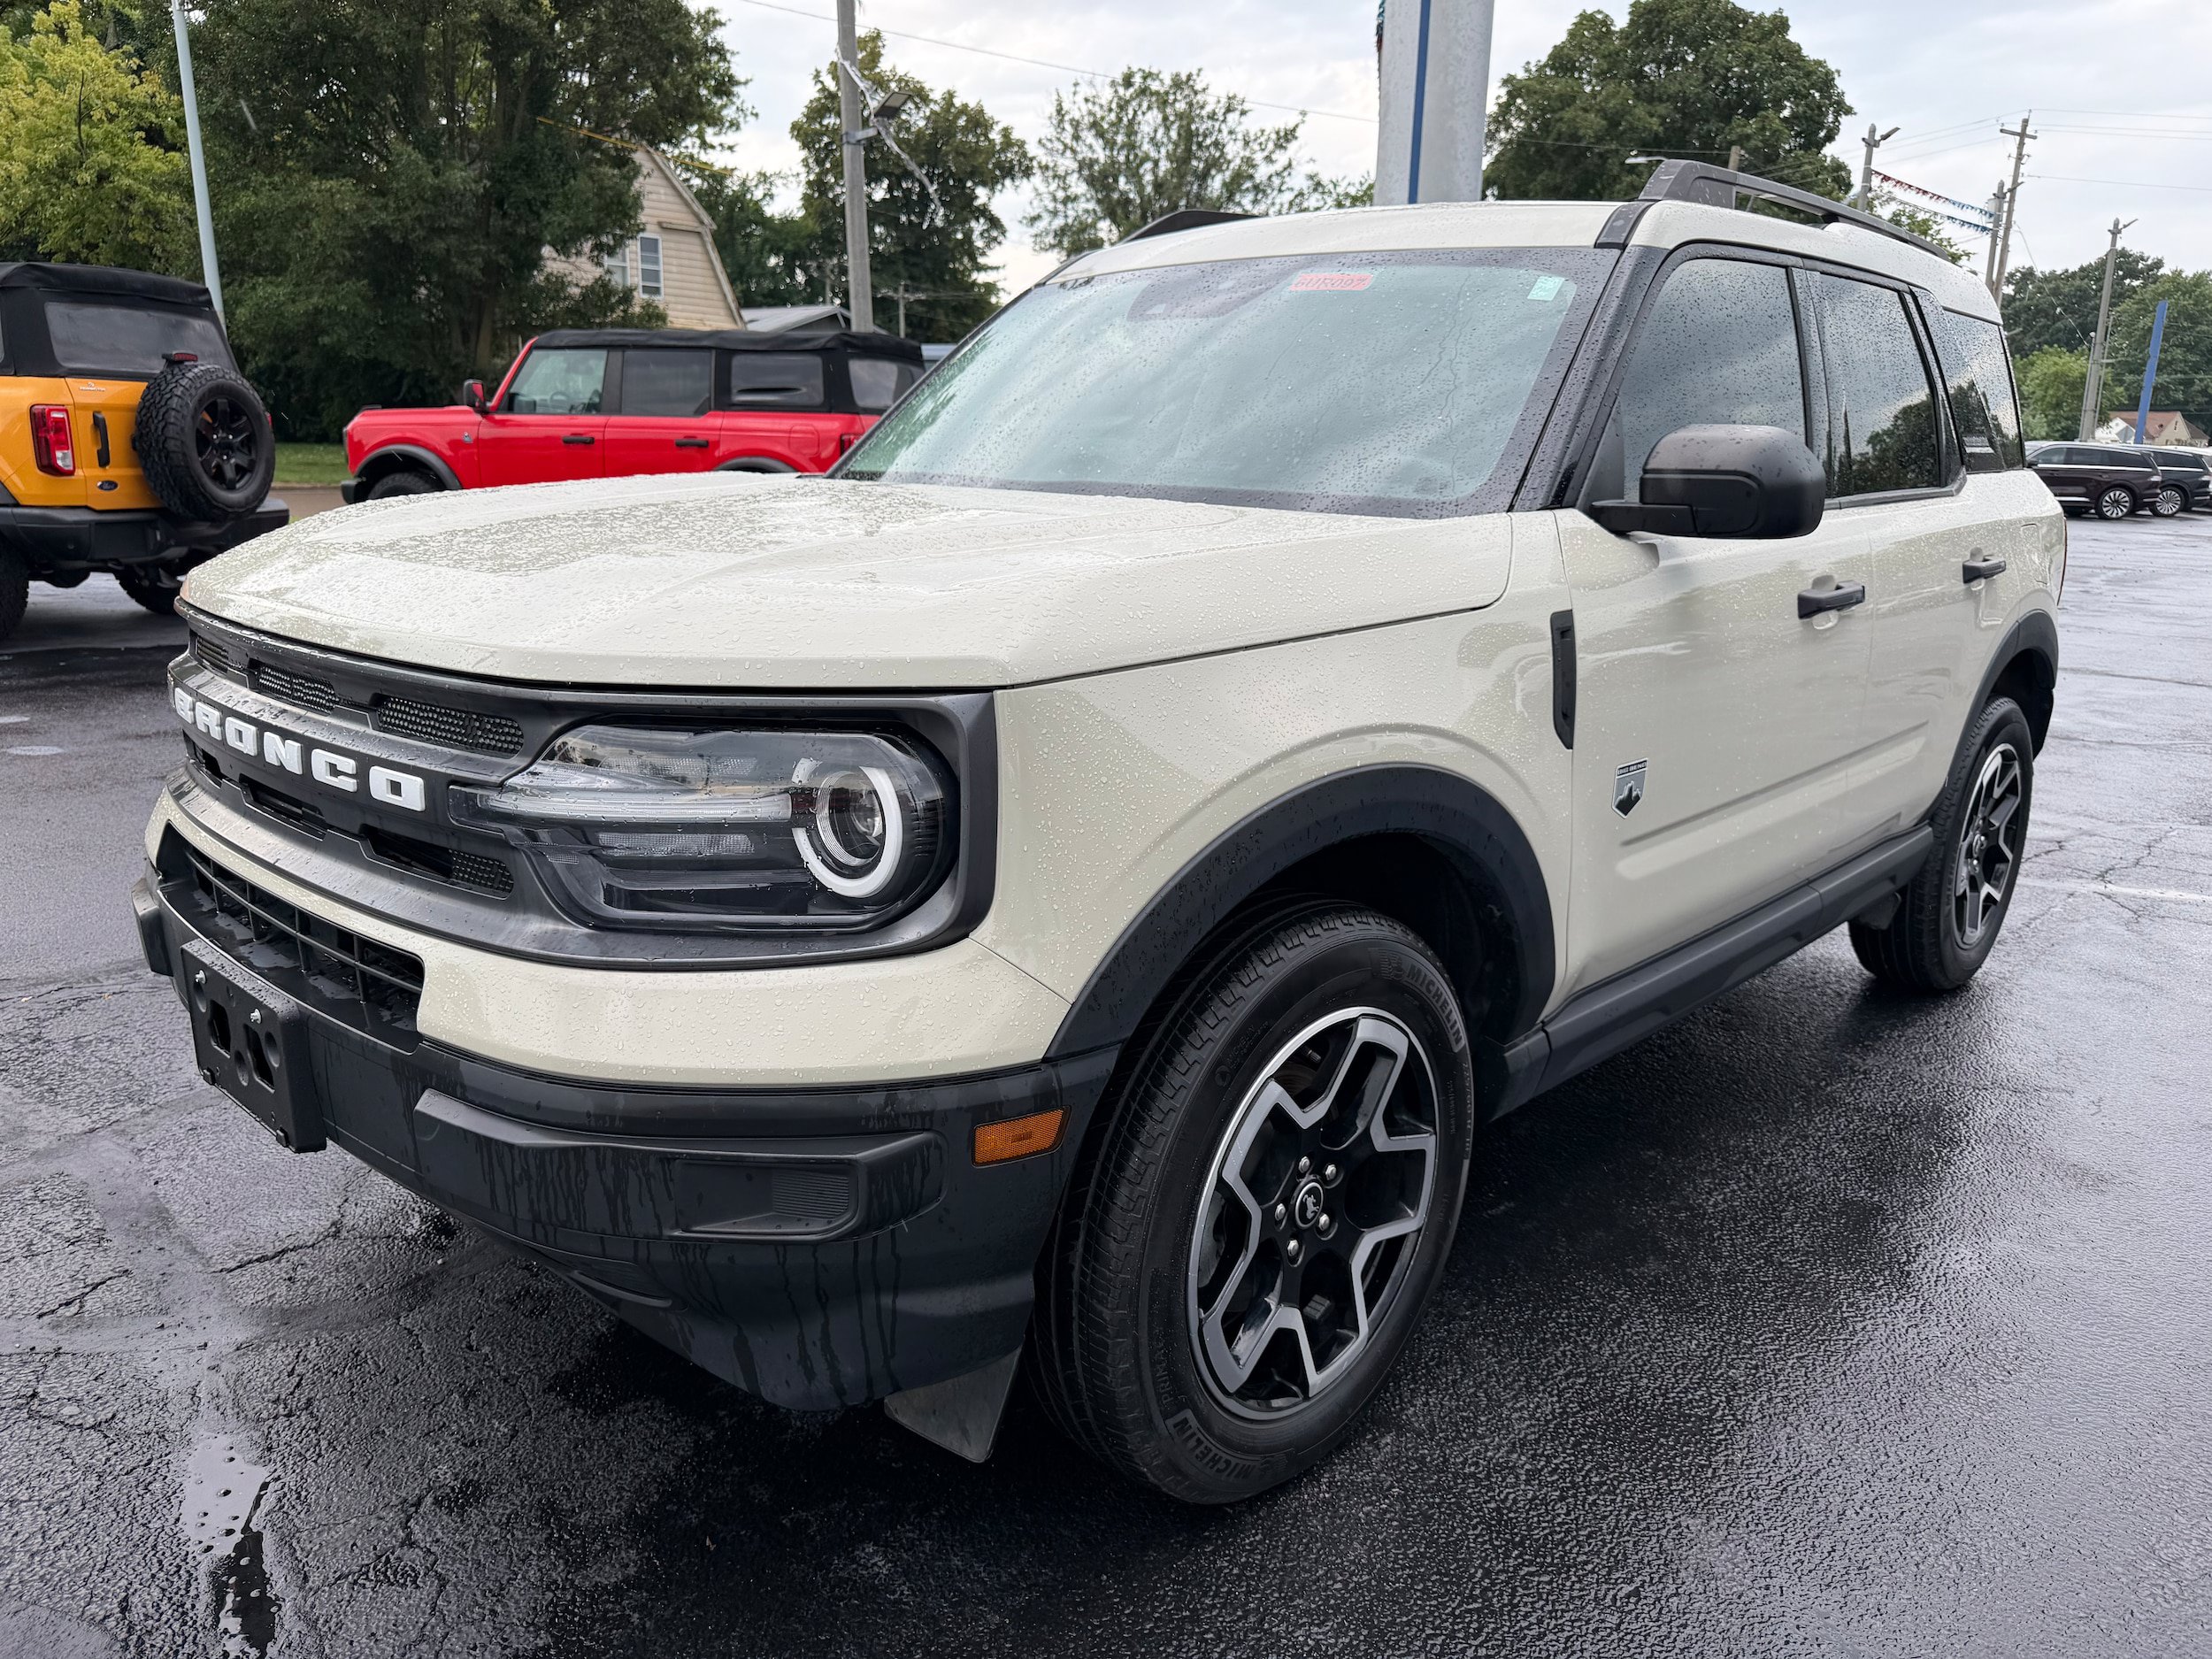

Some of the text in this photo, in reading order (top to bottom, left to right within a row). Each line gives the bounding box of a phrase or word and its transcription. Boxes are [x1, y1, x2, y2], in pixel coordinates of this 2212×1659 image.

[173, 687, 426, 812] BRONCO
[1629, 761, 1647, 772] BEND
[1406, 963, 1463, 1046] MICHELIN
[1172, 1417, 1257, 1479] MICHELIN
